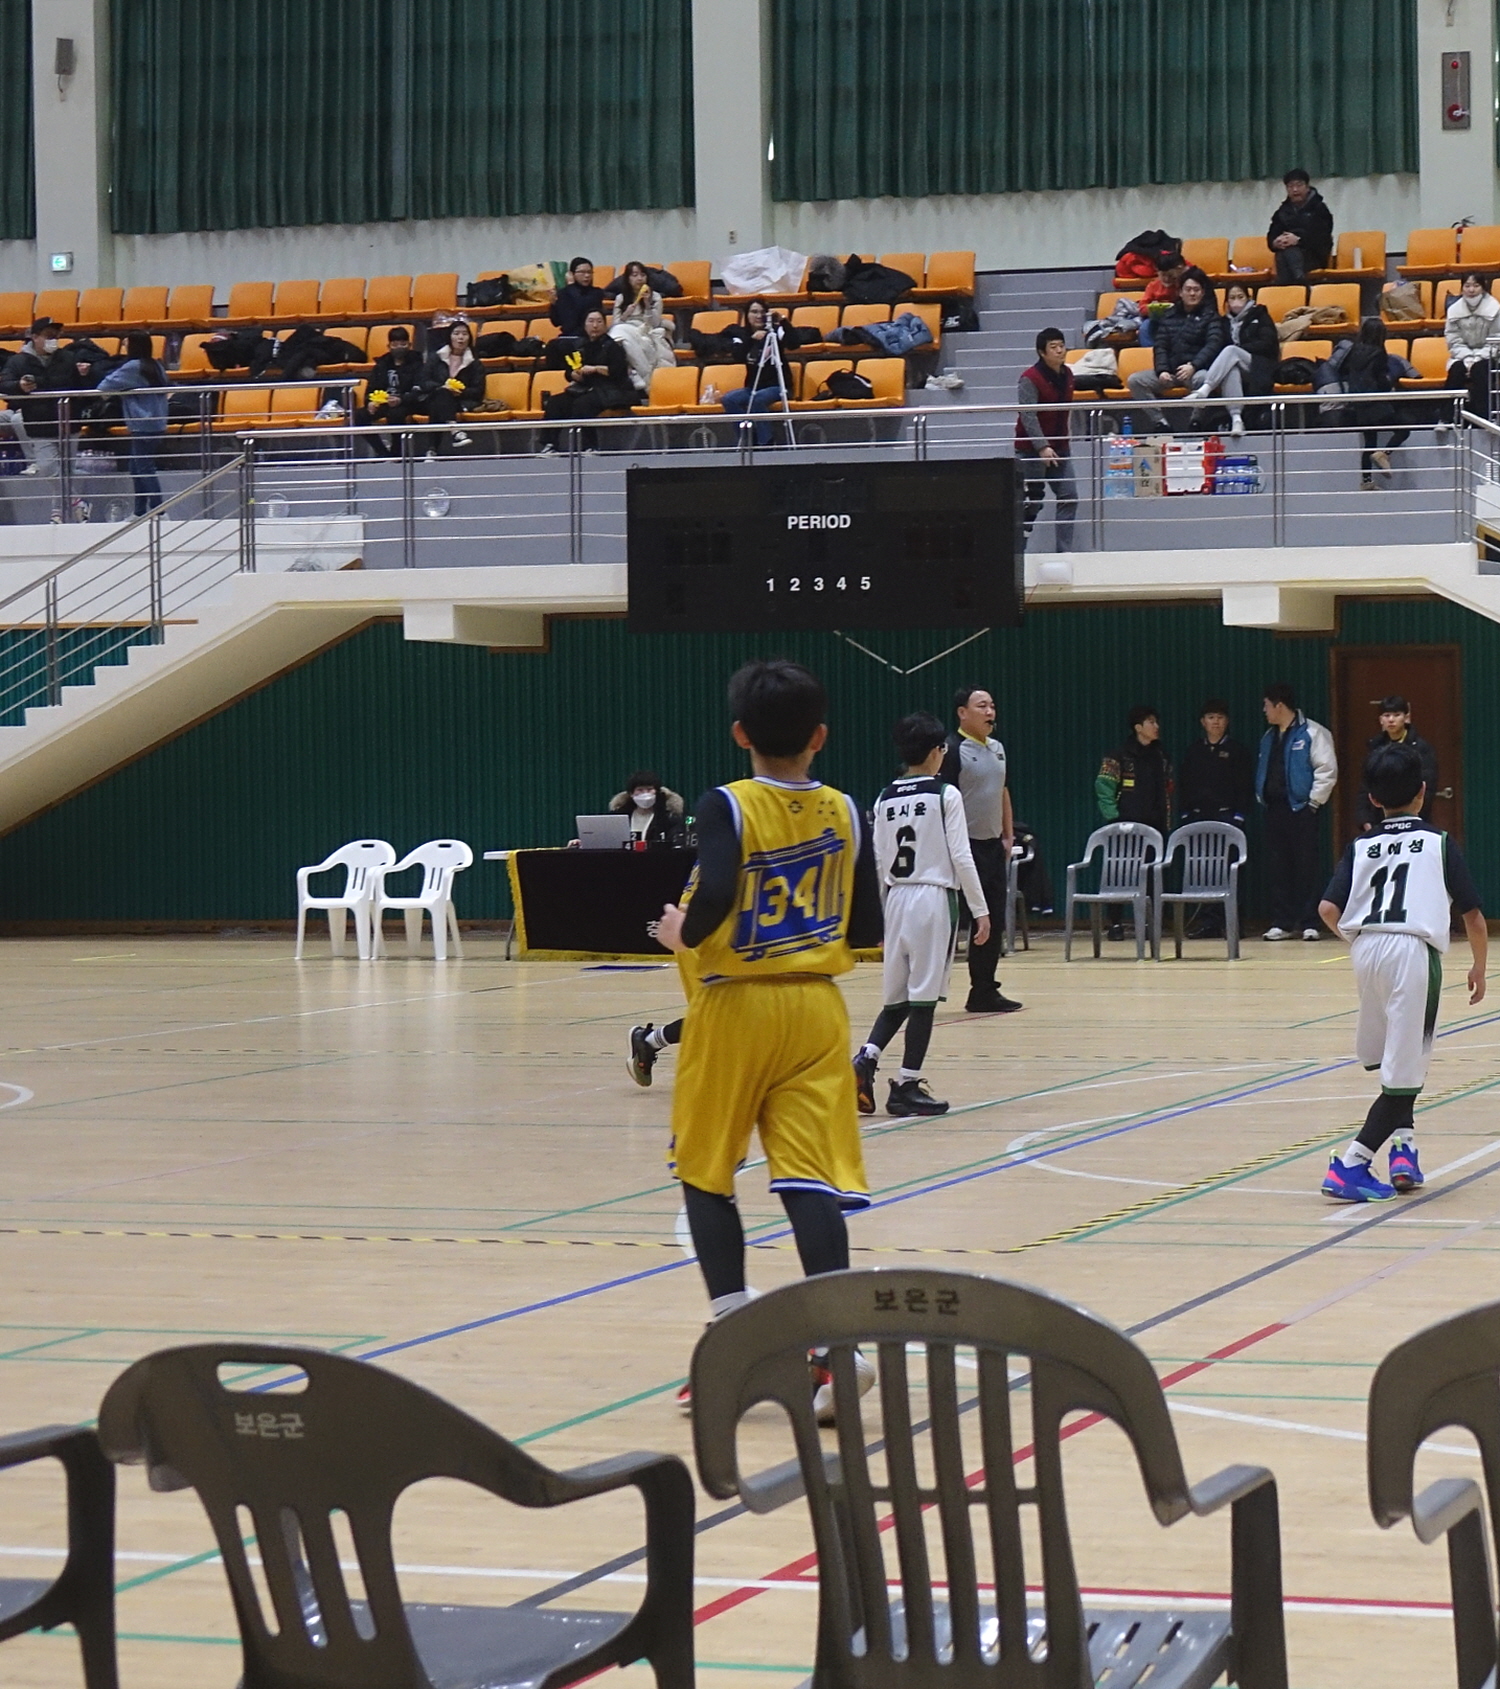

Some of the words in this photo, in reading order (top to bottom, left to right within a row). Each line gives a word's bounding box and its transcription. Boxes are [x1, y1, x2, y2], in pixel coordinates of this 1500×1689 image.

[787, 514, 851, 530] PERIOD
[766, 577, 775, 592] 1
[789, 577, 801, 592] 2
[813, 576, 824, 591] 3
[836, 575, 847, 590] 4
[860, 575, 871, 590] 5
[890, 824, 917, 878] 6
[758, 866, 819, 928] 34
[1361, 862, 1410, 927] 11
[874, 1288, 959, 1315] 보은군
[234, 1412, 305, 1438] 보은군
